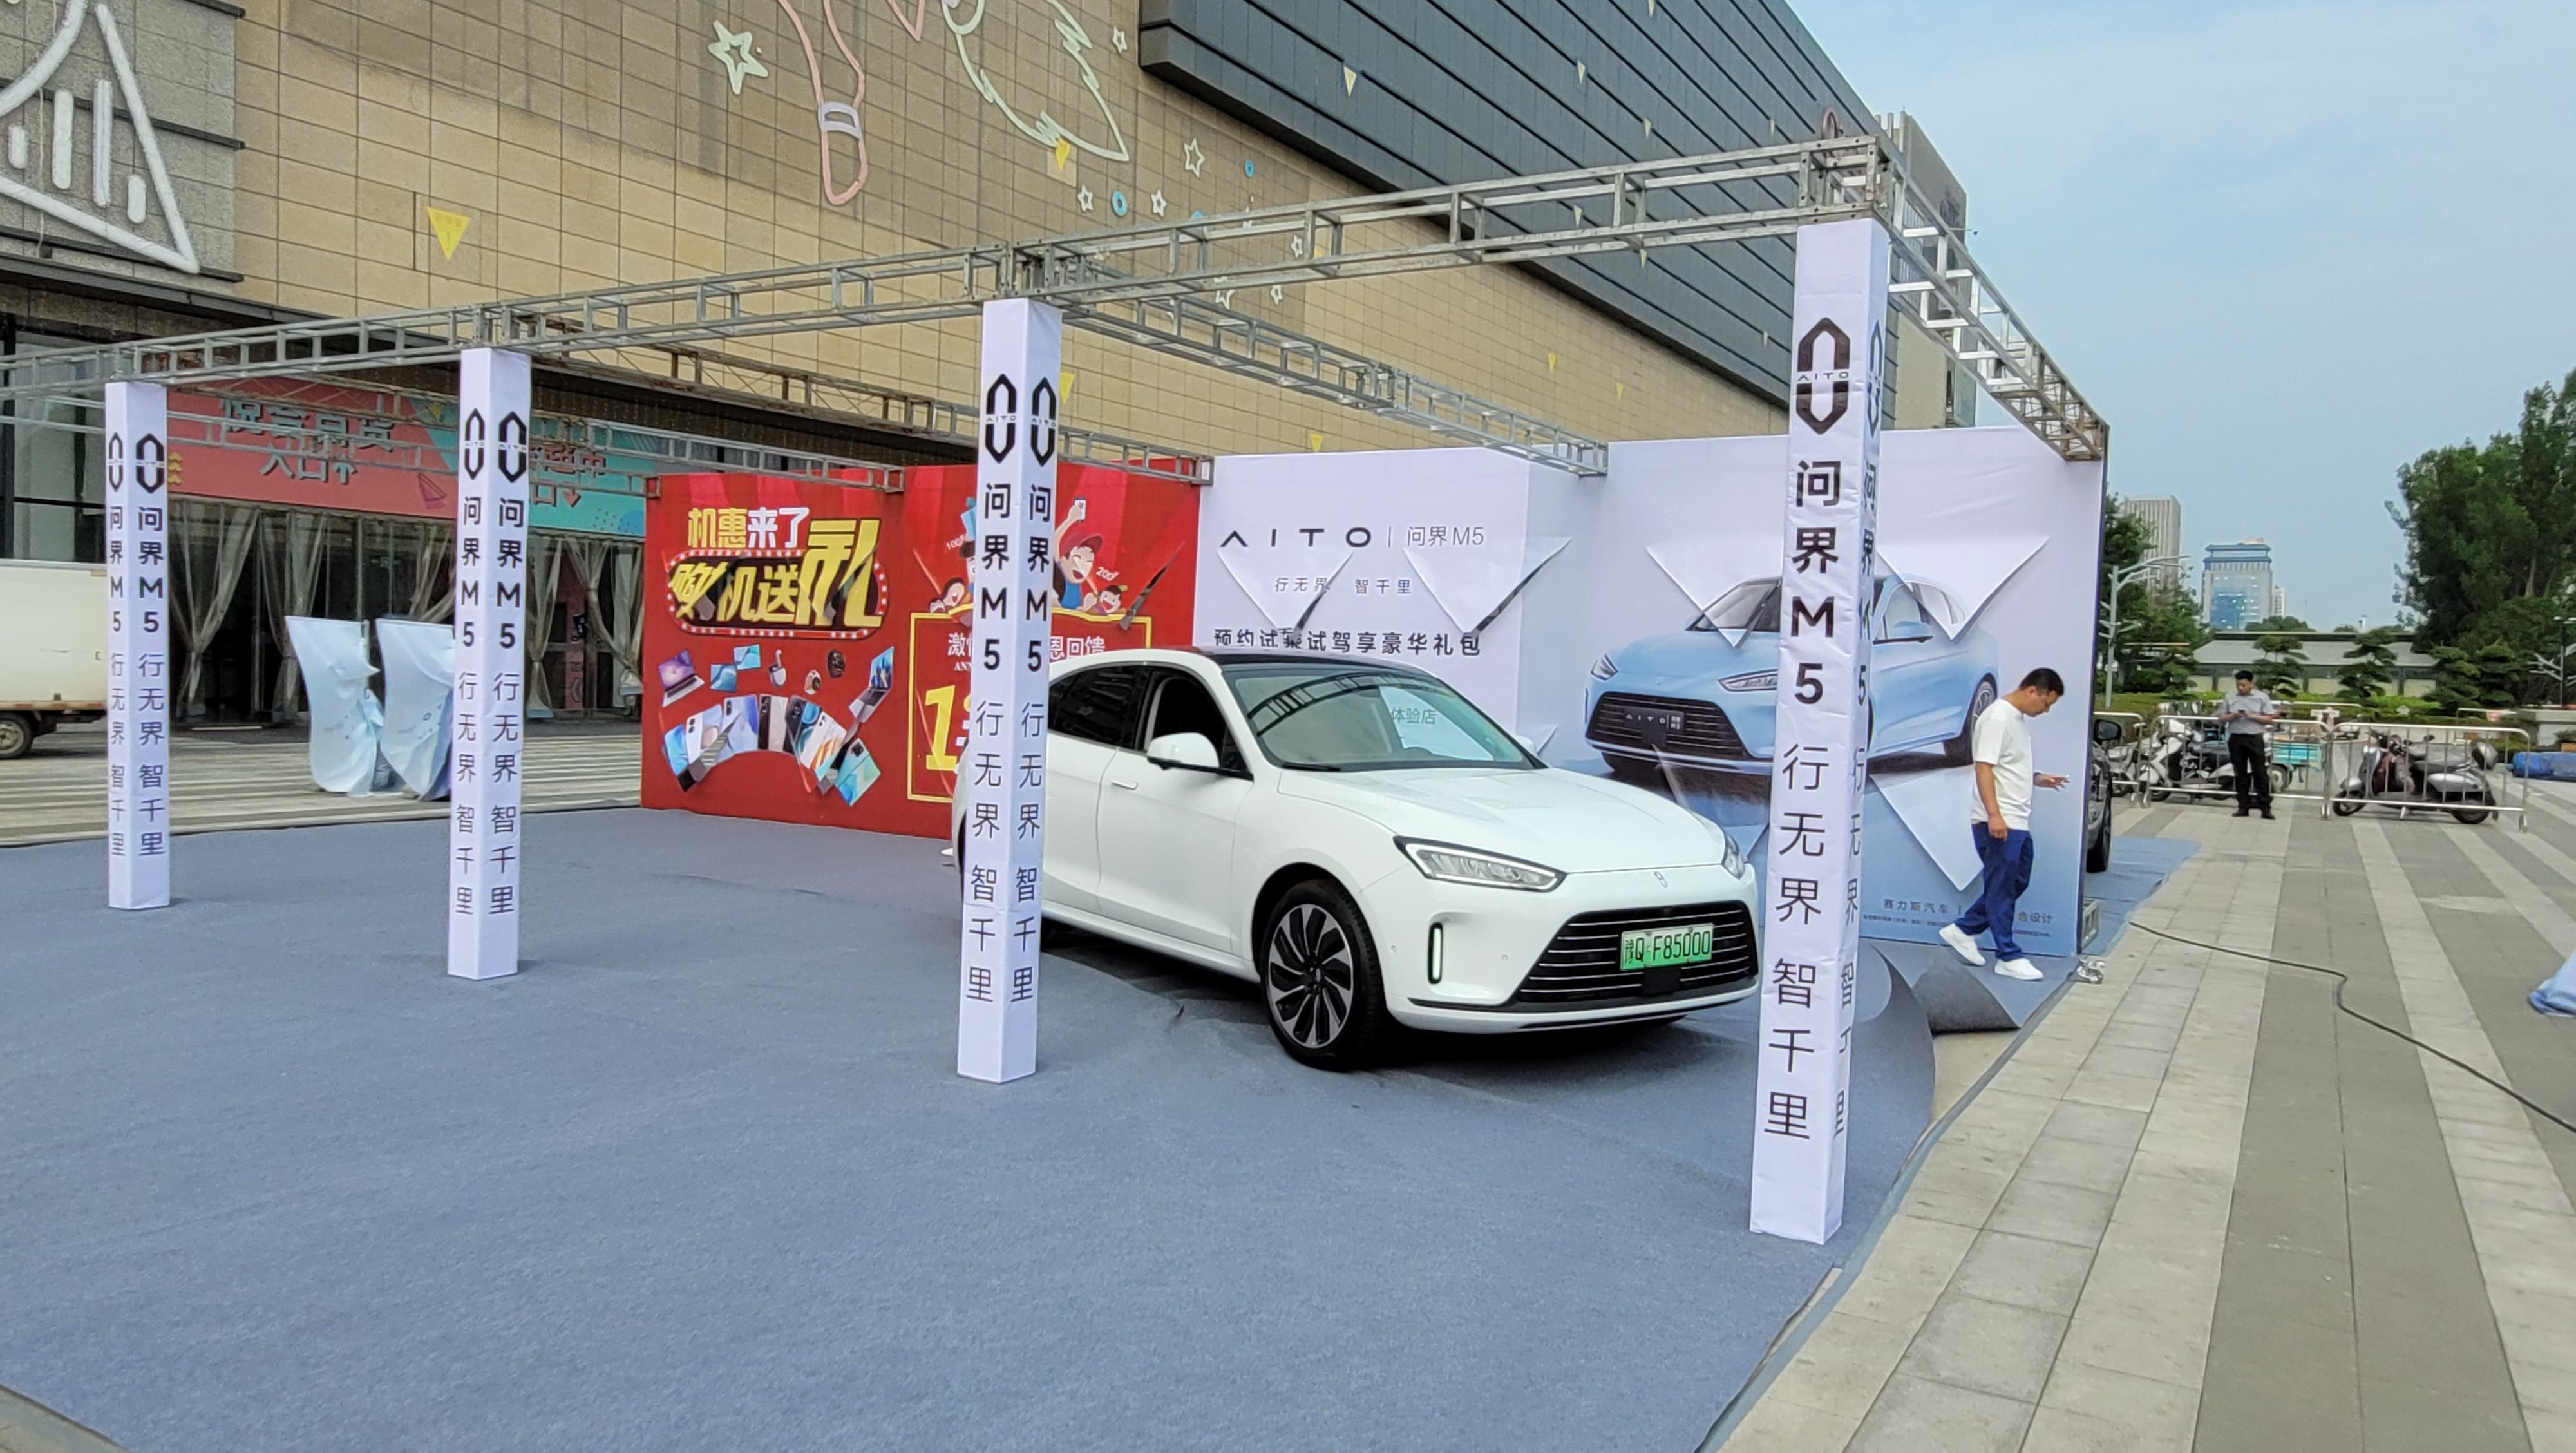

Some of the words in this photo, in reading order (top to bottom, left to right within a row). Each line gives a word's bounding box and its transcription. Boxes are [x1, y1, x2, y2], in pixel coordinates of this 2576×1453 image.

[1797, 372, 1849, 381] AITO
[137, 506, 164, 633] 问界M5
[461, 497, 482, 647] 问界M5
[497, 497, 525, 649] 问界M5
[687, 506, 810, 549] 机惠来了
[981, 482, 1012, 670] 问界M5
[1025, 484, 1051, 672] 问界M5
[1219, 527, 1372, 547] AITO
[1406, 526, 1484, 547] 问界M5
[1274, 576, 1331, 594] 行无界
[1355, 578, 1412, 594] 智千里
[1790, 460, 1841, 705] 问界M5
[138, 652, 166, 746] 行无界
[1214, 627, 1481, 656] 预约试乘试驾享豪华礼包
[457, 671, 478, 783] 行无界
[491, 672, 520, 783] 行无界
[972, 700, 1004, 839] 行无界
[1017, 701, 1045, 840] 行无界
[138, 764, 166, 857] 智千里
[455, 804, 475, 915] 智千里
[488, 804, 516, 915] 智千里
[1775, 743, 1830, 925] 行无界
[966, 864, 997, 1003] 智千里
[1010, 866, 1037, 1003] 智千里
[1653, 931, 1710, 962] F85000
[1763, 958, 1816, 1140] 智千里
